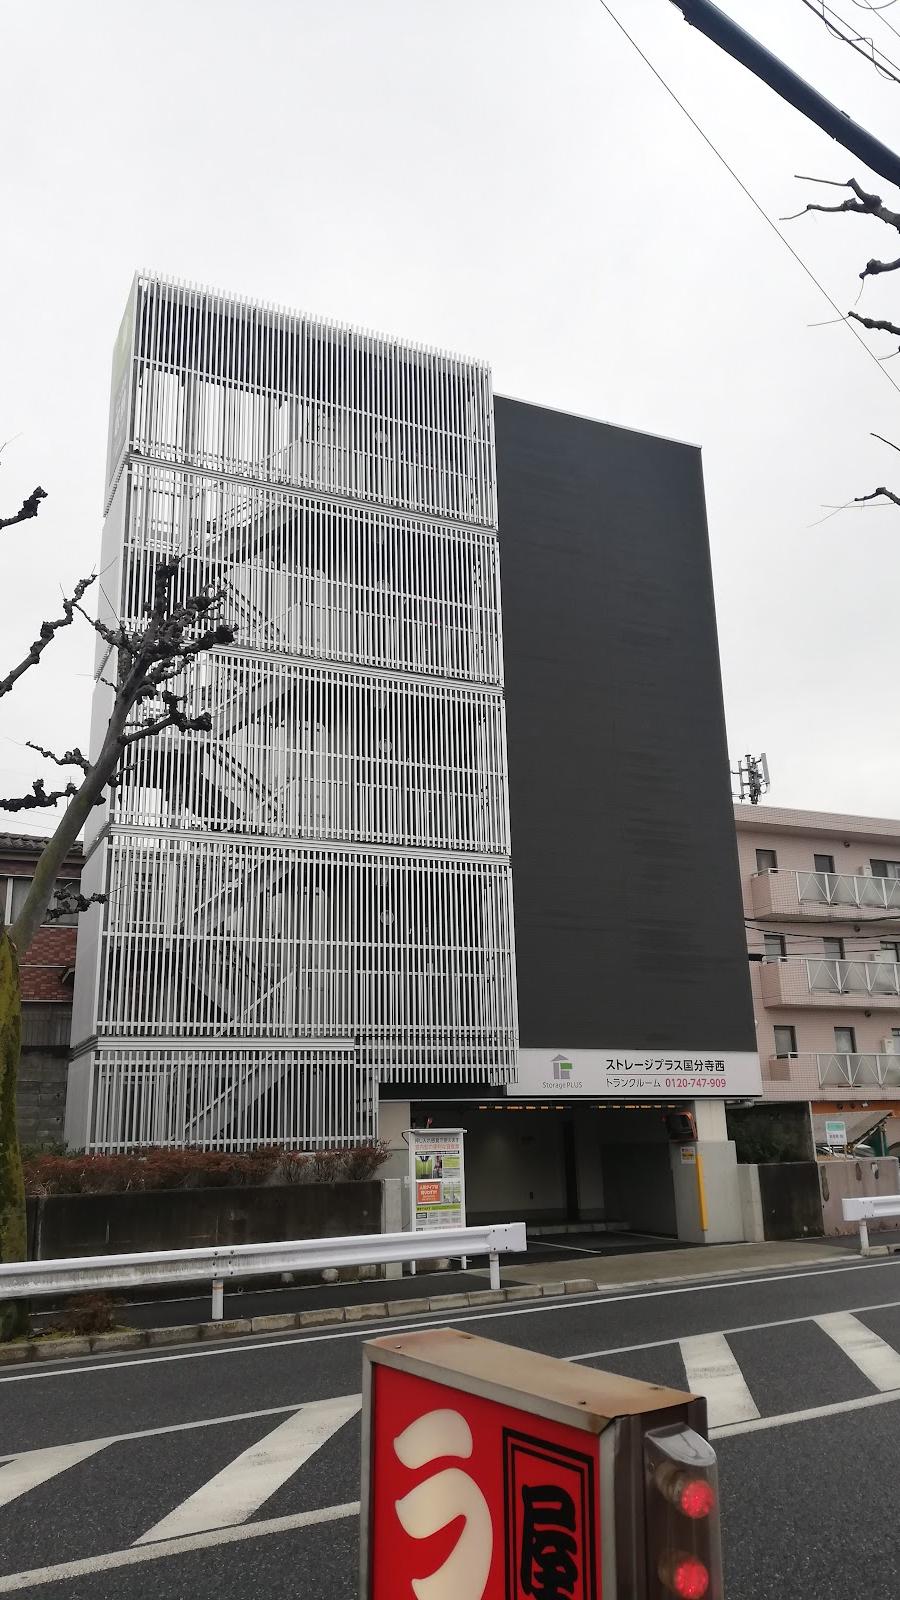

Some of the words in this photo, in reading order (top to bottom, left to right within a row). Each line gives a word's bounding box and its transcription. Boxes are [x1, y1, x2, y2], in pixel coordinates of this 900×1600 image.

[606, 1059, 725, 1072] ストレージプラス国分寺西
[606, 1078, 661, 1088] トランクルーム
[665, 1078, 727, 1088] 0120-747-909
[393, 1408, 494, 1600] う
